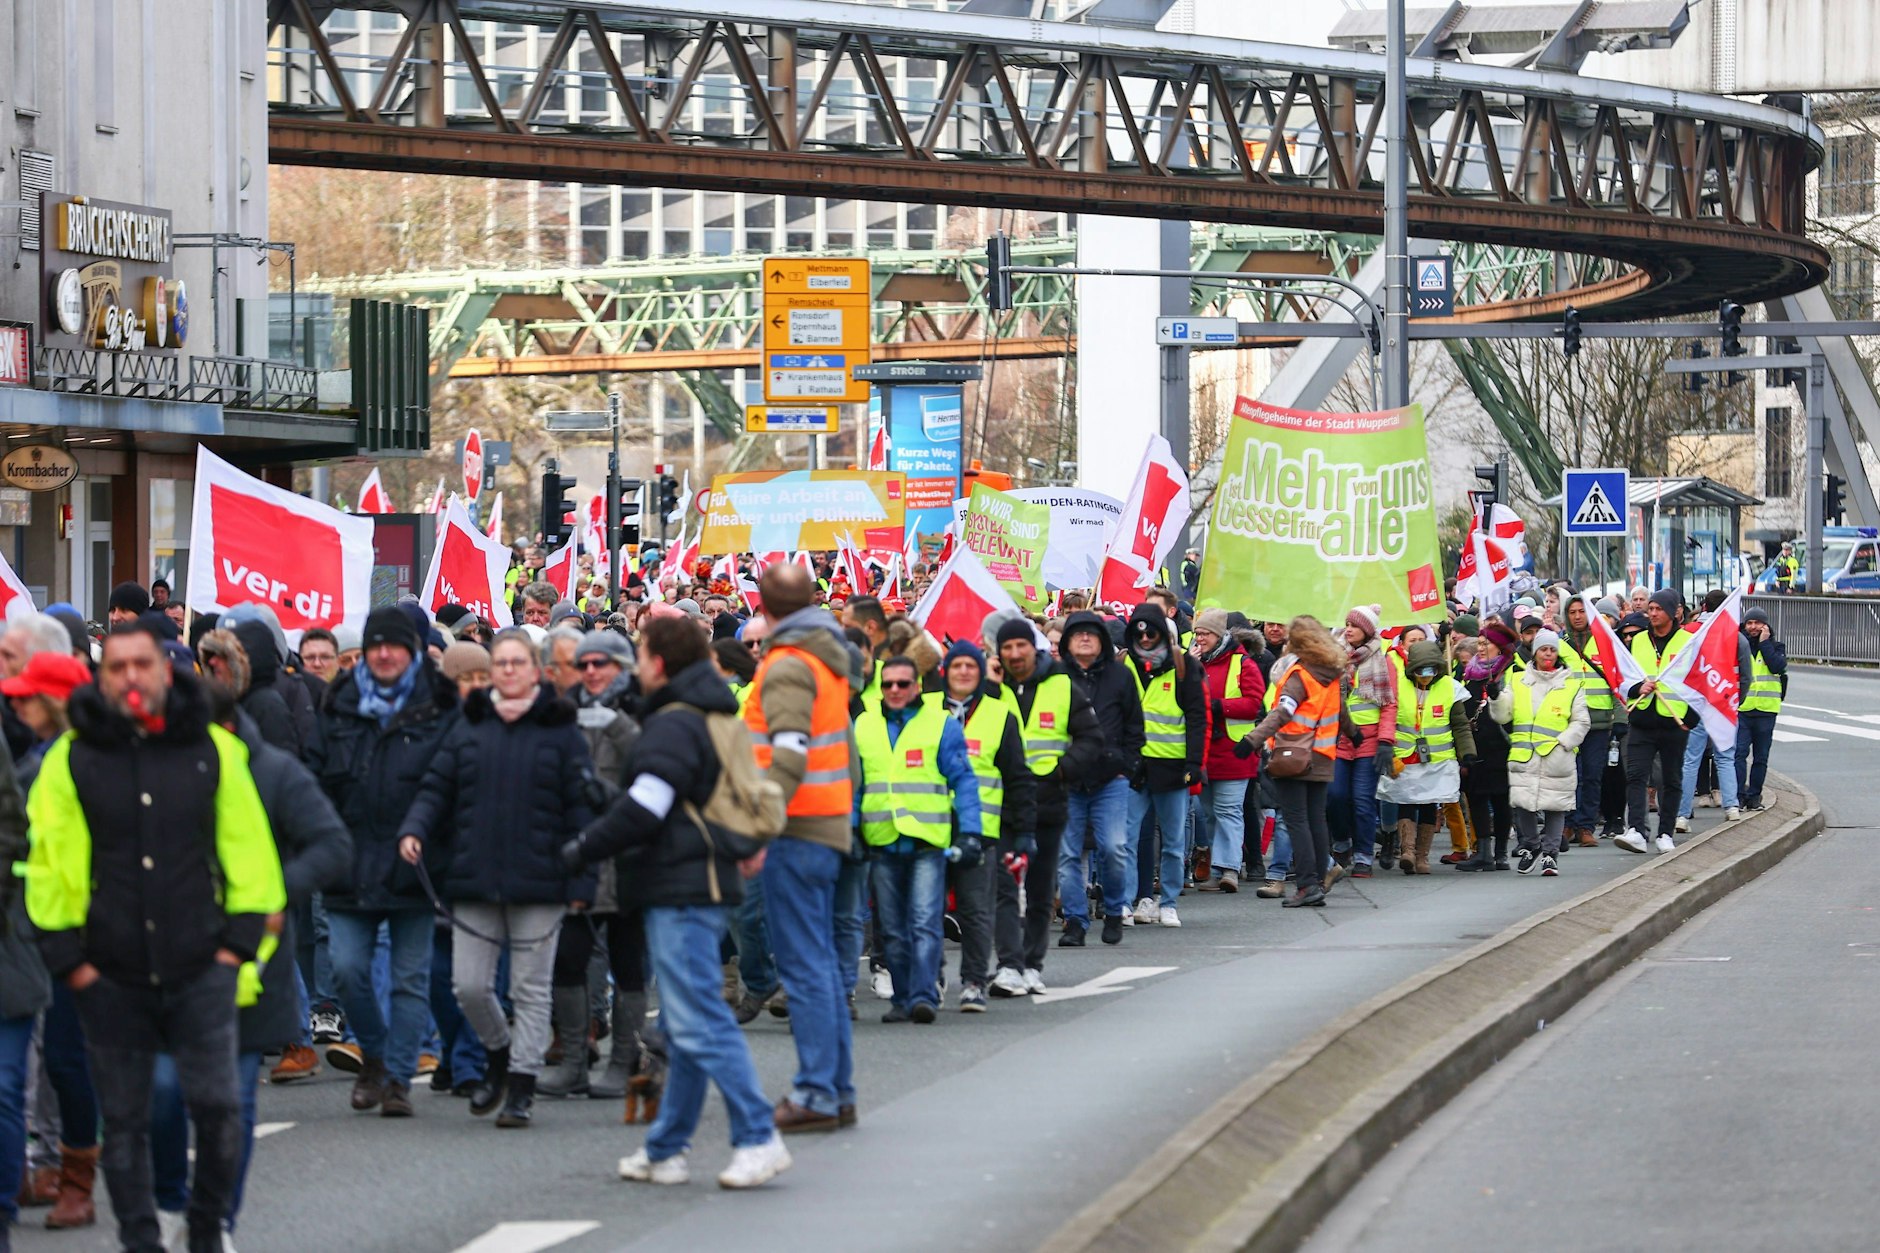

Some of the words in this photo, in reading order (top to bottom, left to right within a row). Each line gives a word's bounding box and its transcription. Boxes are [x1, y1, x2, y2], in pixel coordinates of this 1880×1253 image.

[807, 265, 849, 273] Mettmann
[810, 278, 849, 286] Elberfeld
[788, 297, 835, 306] Remscheid
[792, 323, 837, 331] Opernhaus
[807, 335, 840, 343] Barmen
[787, 373, 843, 381] Krankenhaus
[890, 366, 927, 376] STRÖER
[809, 385, 843, 393] Rathaus
[1305, 416, 1324, 428] der
[1326, 417, 1355, 429] Stadt
[1357, 414, 1400, 431] Wuppertal
[897, 447, 930, 458] Kurze
[931, 447, 957, 460] Wege
[7, 462, 70, 477] Krombacher
[897, 460, 914, 471] für
[916, 461, 954, 471] Pakete.
[1243, 442, 1360, 512] Mehr
[1353, 481, 1378, 496] von
[1381, 460, 1428, 510] uns
[1229, 479, 1244, 501] ist
[710, 492, 729, 508] Für
[733, 489, 772, 505] faire
[777, 488, 839, 505] Arbeit
[843, 489, 867, 503] an
[708, 511, 765, 527] Theater
[769, 508, 808, 525] und
[813, 506, 883, 523] Bühnen
[1219, 485, 1305, 538] besser
[1299, 519, 1325, 540] für
[1320, 497, 1404, 557] alle
[1010, 519, 1040, 539] SIND
[223, 557, 333, 620] ver.di
